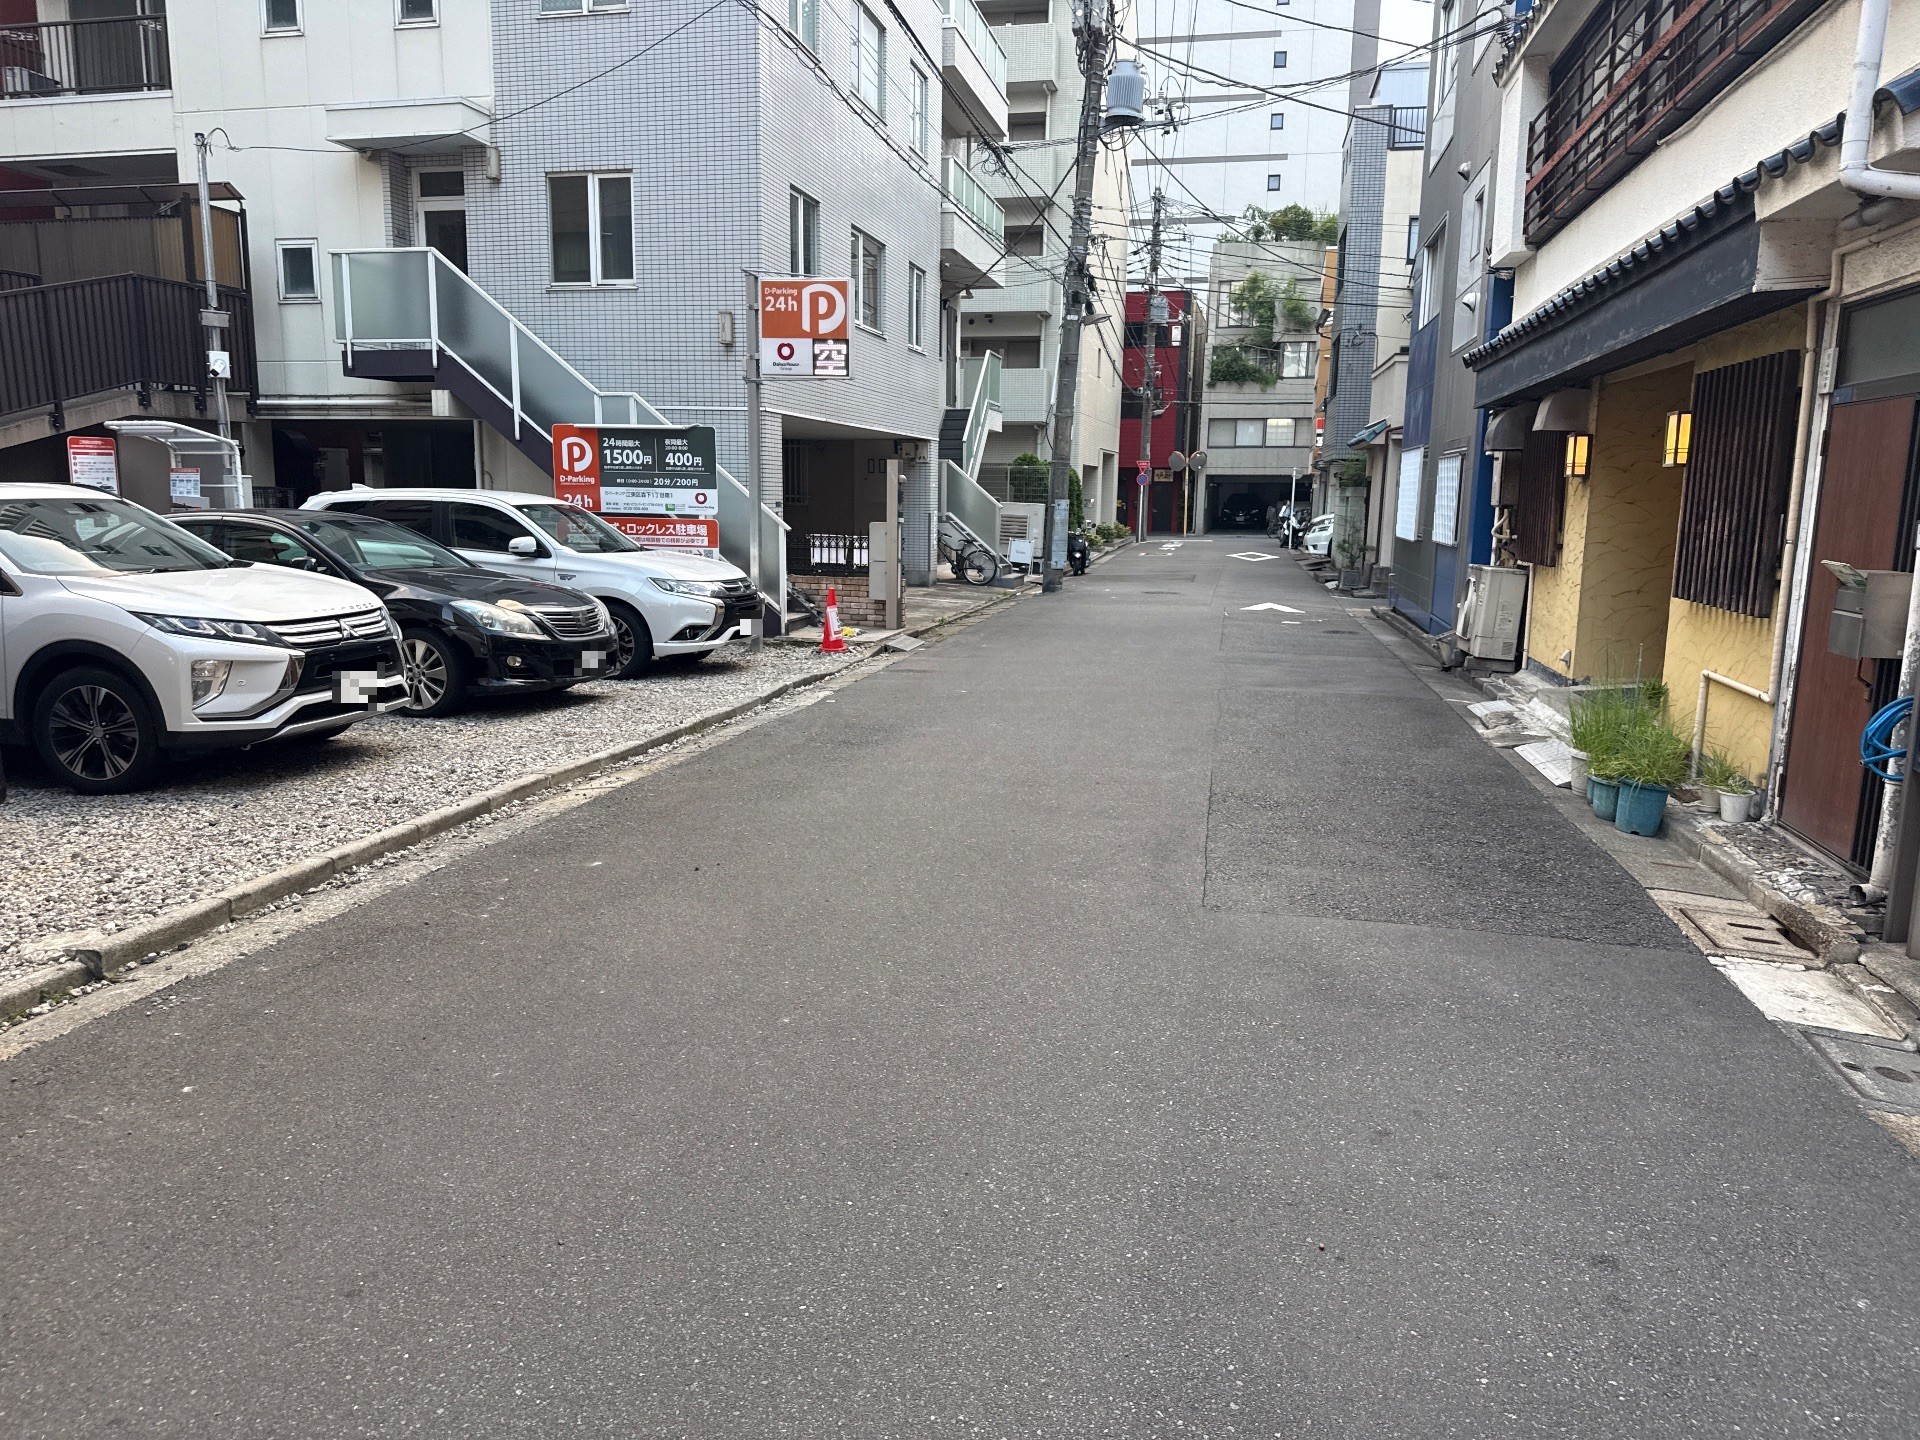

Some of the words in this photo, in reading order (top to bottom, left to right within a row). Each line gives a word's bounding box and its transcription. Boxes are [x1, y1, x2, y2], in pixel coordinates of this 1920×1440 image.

[764, 287, 798, 297] D-Parking
[765, 296, 798, 312] 24h
[814, 340, 847, 375] 空
[602, 437, 641, 448] 24時間最大
[603, 449, 652, 465] 1500円
[665, 452, 702, 467] 400円
[559, 475, 596, 485] D-Parking
[653, 477, 699, 487] 20分/200円
